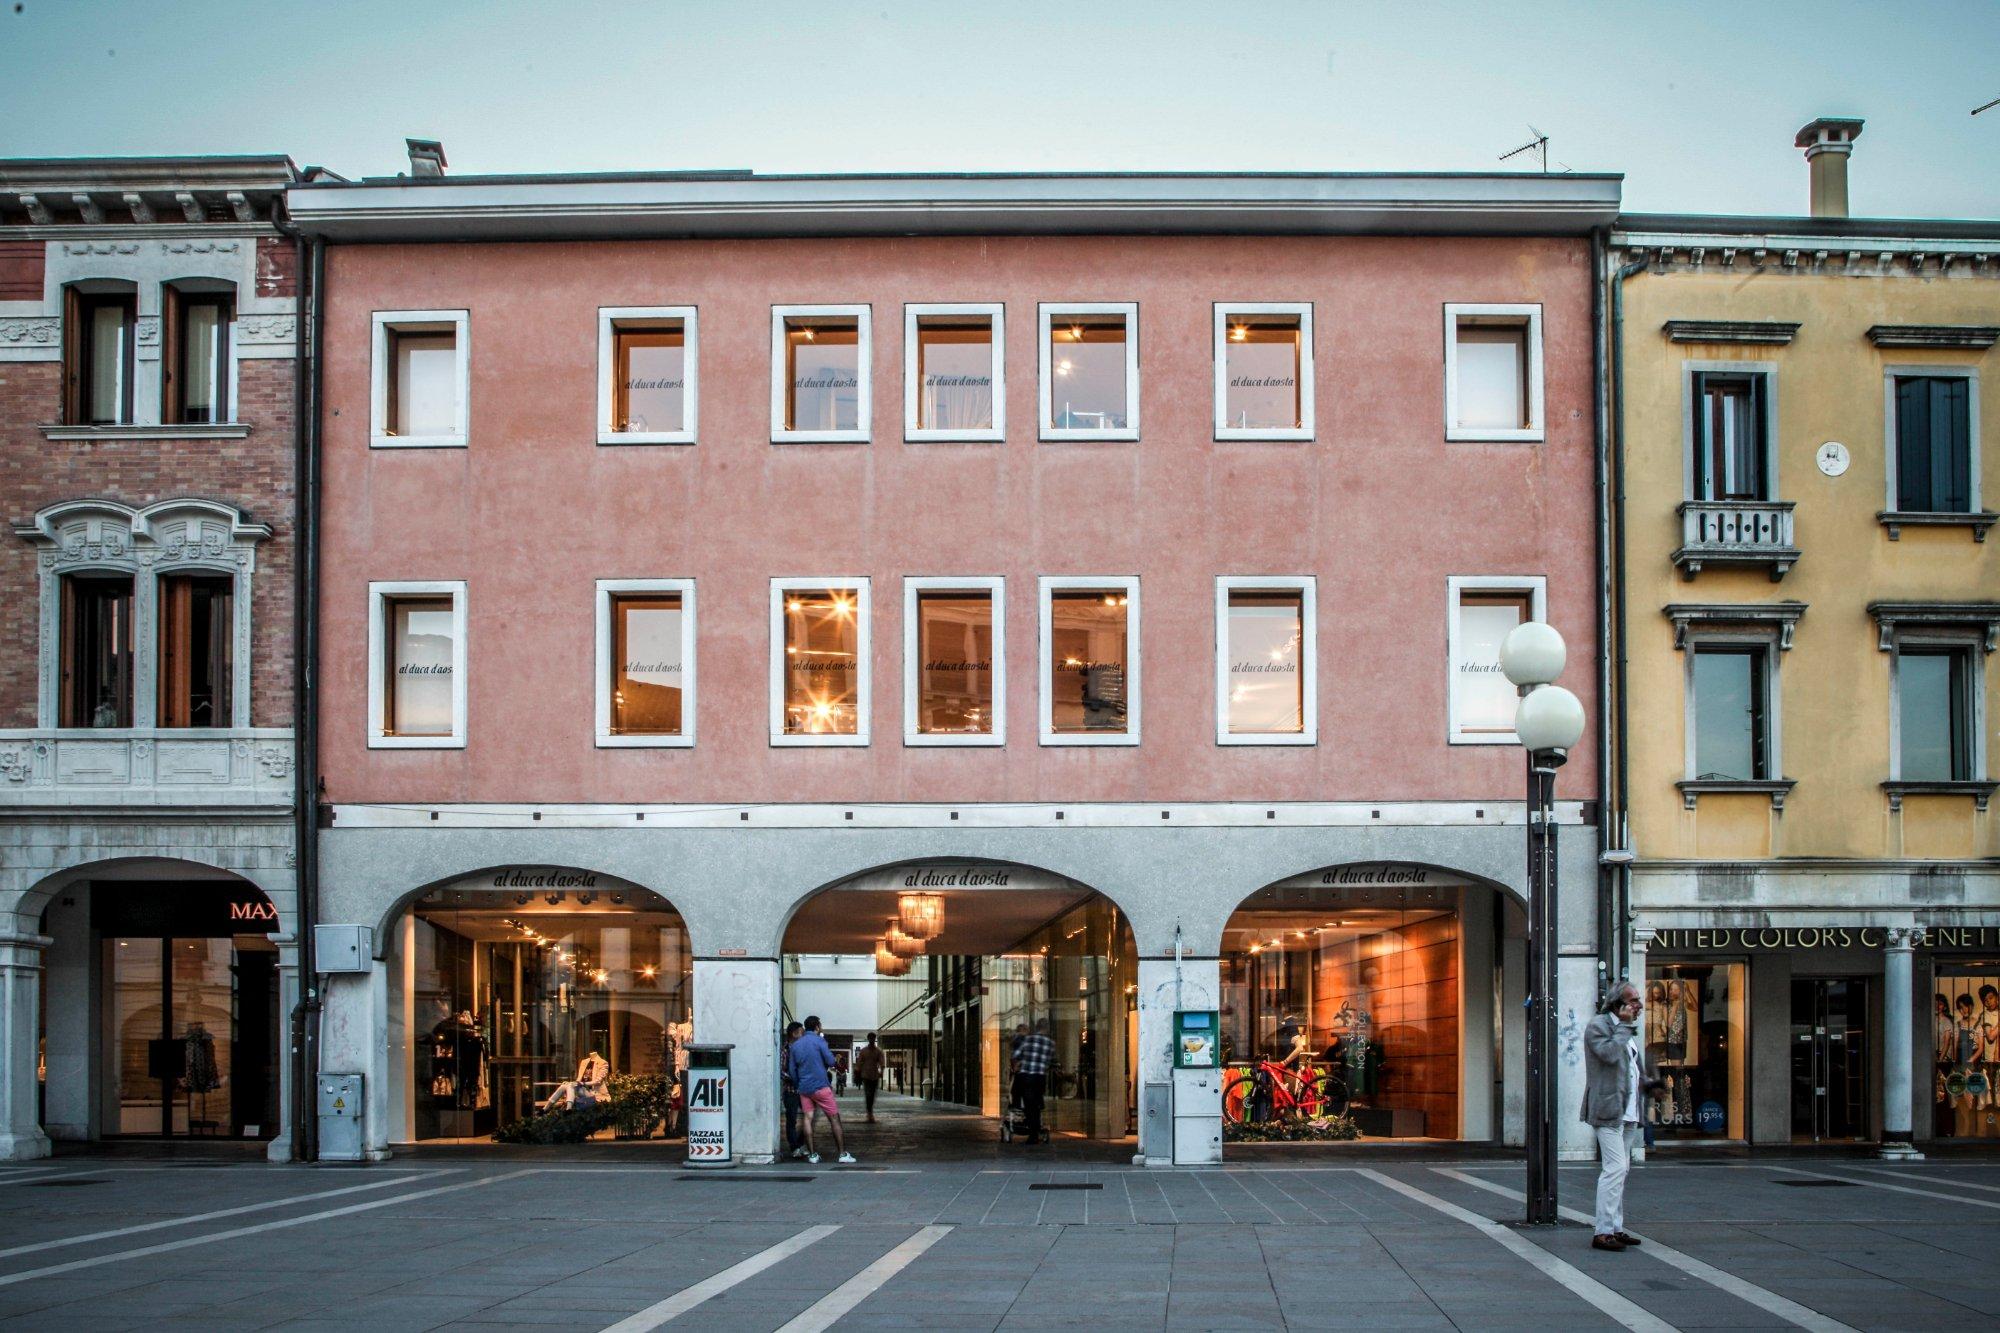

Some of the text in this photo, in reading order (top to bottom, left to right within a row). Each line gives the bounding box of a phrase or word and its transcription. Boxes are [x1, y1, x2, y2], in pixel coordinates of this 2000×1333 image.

[625, 378, 634, 389] al
[635, 378, 654, 389] duca
[794, 378, 804, 388] al
[804, 378, 824, 388] duca
[926, 376, 936, 386] al
[936, 376, 957, 386] duca
[1230, 377, 1240, 387] al
[1240, 377, 1261, 387] duca
[399, 664, 408, 674] al
[408, 664, 429, 674] duca
[622, 662, 632, 672] al
[633, 662, 654, 672] duca
[794, 660, 803, 671] al
[803, 660, 824, 671] duca
[926, 660, 935, 671] al
[936, 660, 957, 671] duca
[1232, 662, 1242, 672] al
[1242, 662, 1262, 672] duca
[1460, 662, 1468, 673] al
[1469, 662, 1489, 673] duca
[494, 870, 510, 887] al
[510, 870, 543, 887] duca
[905, 868, 921, 886] al
[922, 868, 956, 886] duca
[1322, 867, 1338, 884] al
[1340, 867, 1374, 883] duca
[1649, 930, 1731, 947] NITED
[1740, 929, 1851, 948] COLORS
